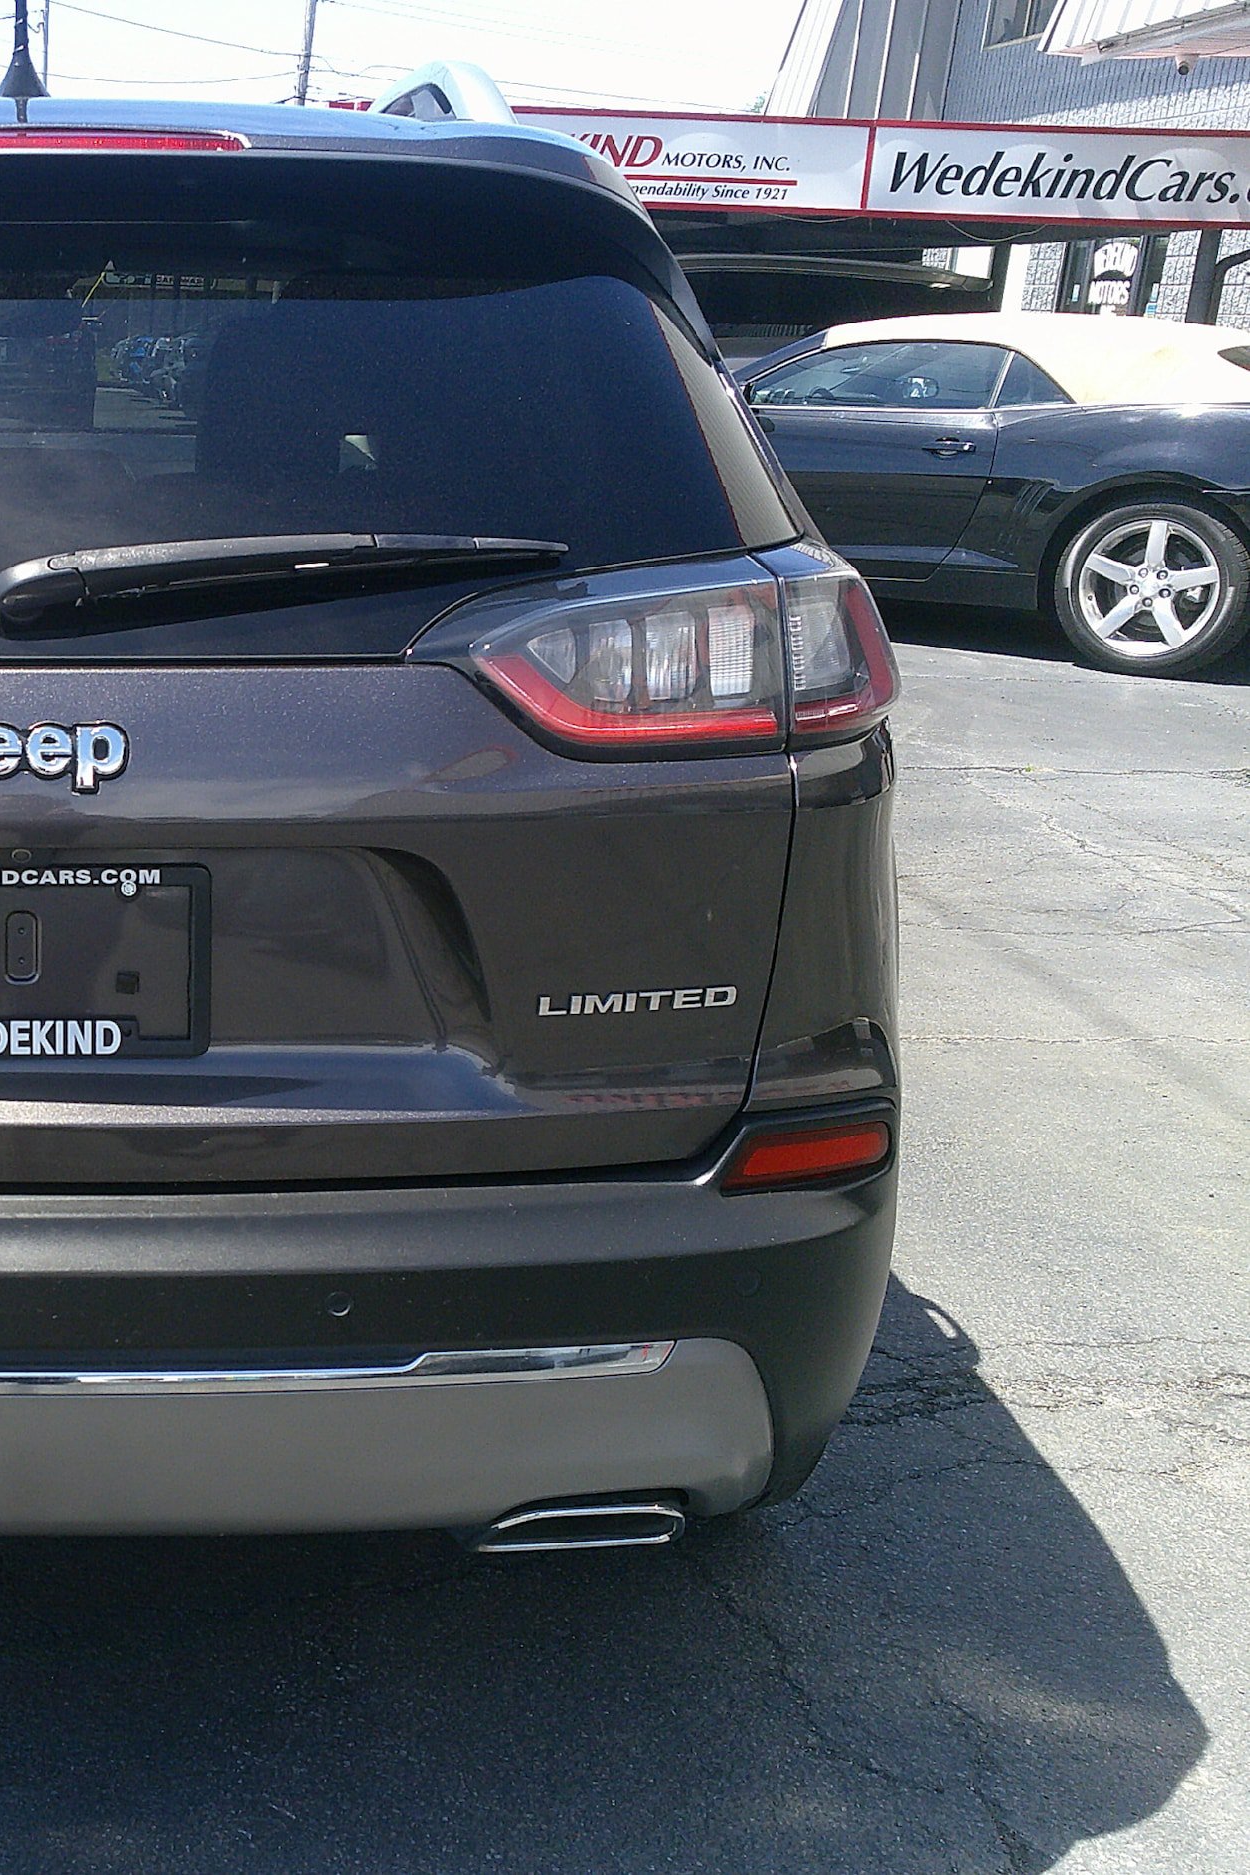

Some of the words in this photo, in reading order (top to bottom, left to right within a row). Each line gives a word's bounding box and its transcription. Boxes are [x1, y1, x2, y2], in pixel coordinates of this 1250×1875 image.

[661, 152, 747, 173] MOTORS,
[752, 155, 791, 172] INC.
[711, 184, 750, 200] Since
[755, 187, 789, 201] 1921
[538, 985, 737, 1017] LIMITED
